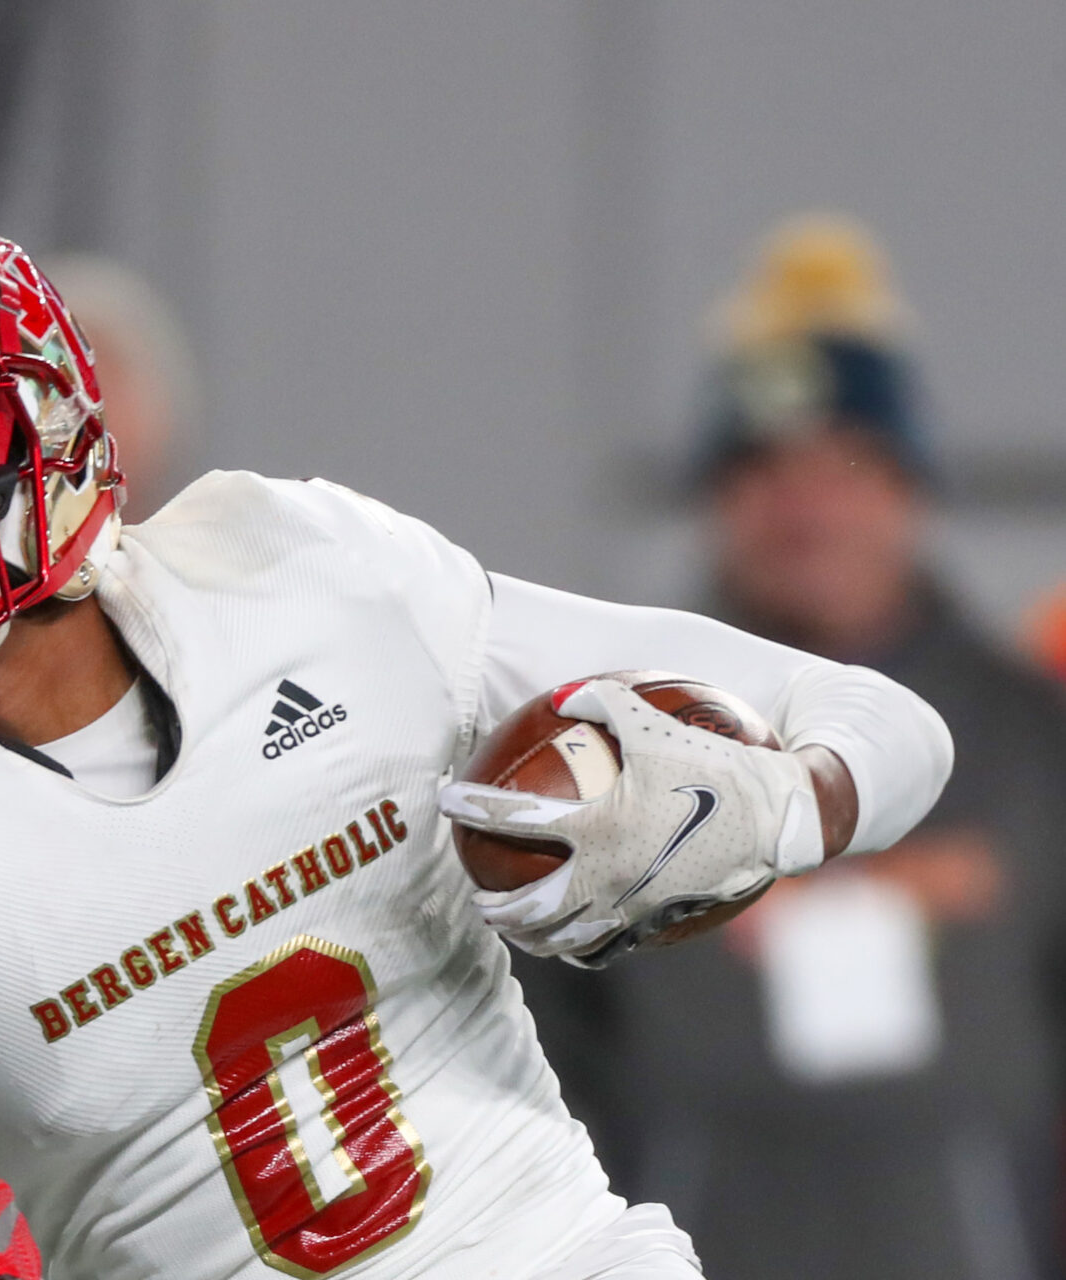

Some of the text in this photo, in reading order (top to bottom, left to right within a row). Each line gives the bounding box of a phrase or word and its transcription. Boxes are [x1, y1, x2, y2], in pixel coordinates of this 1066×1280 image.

[262, 703, 347, 760] adidas
[30, 799, 407, 1043] BERGEN CATHOLIC
